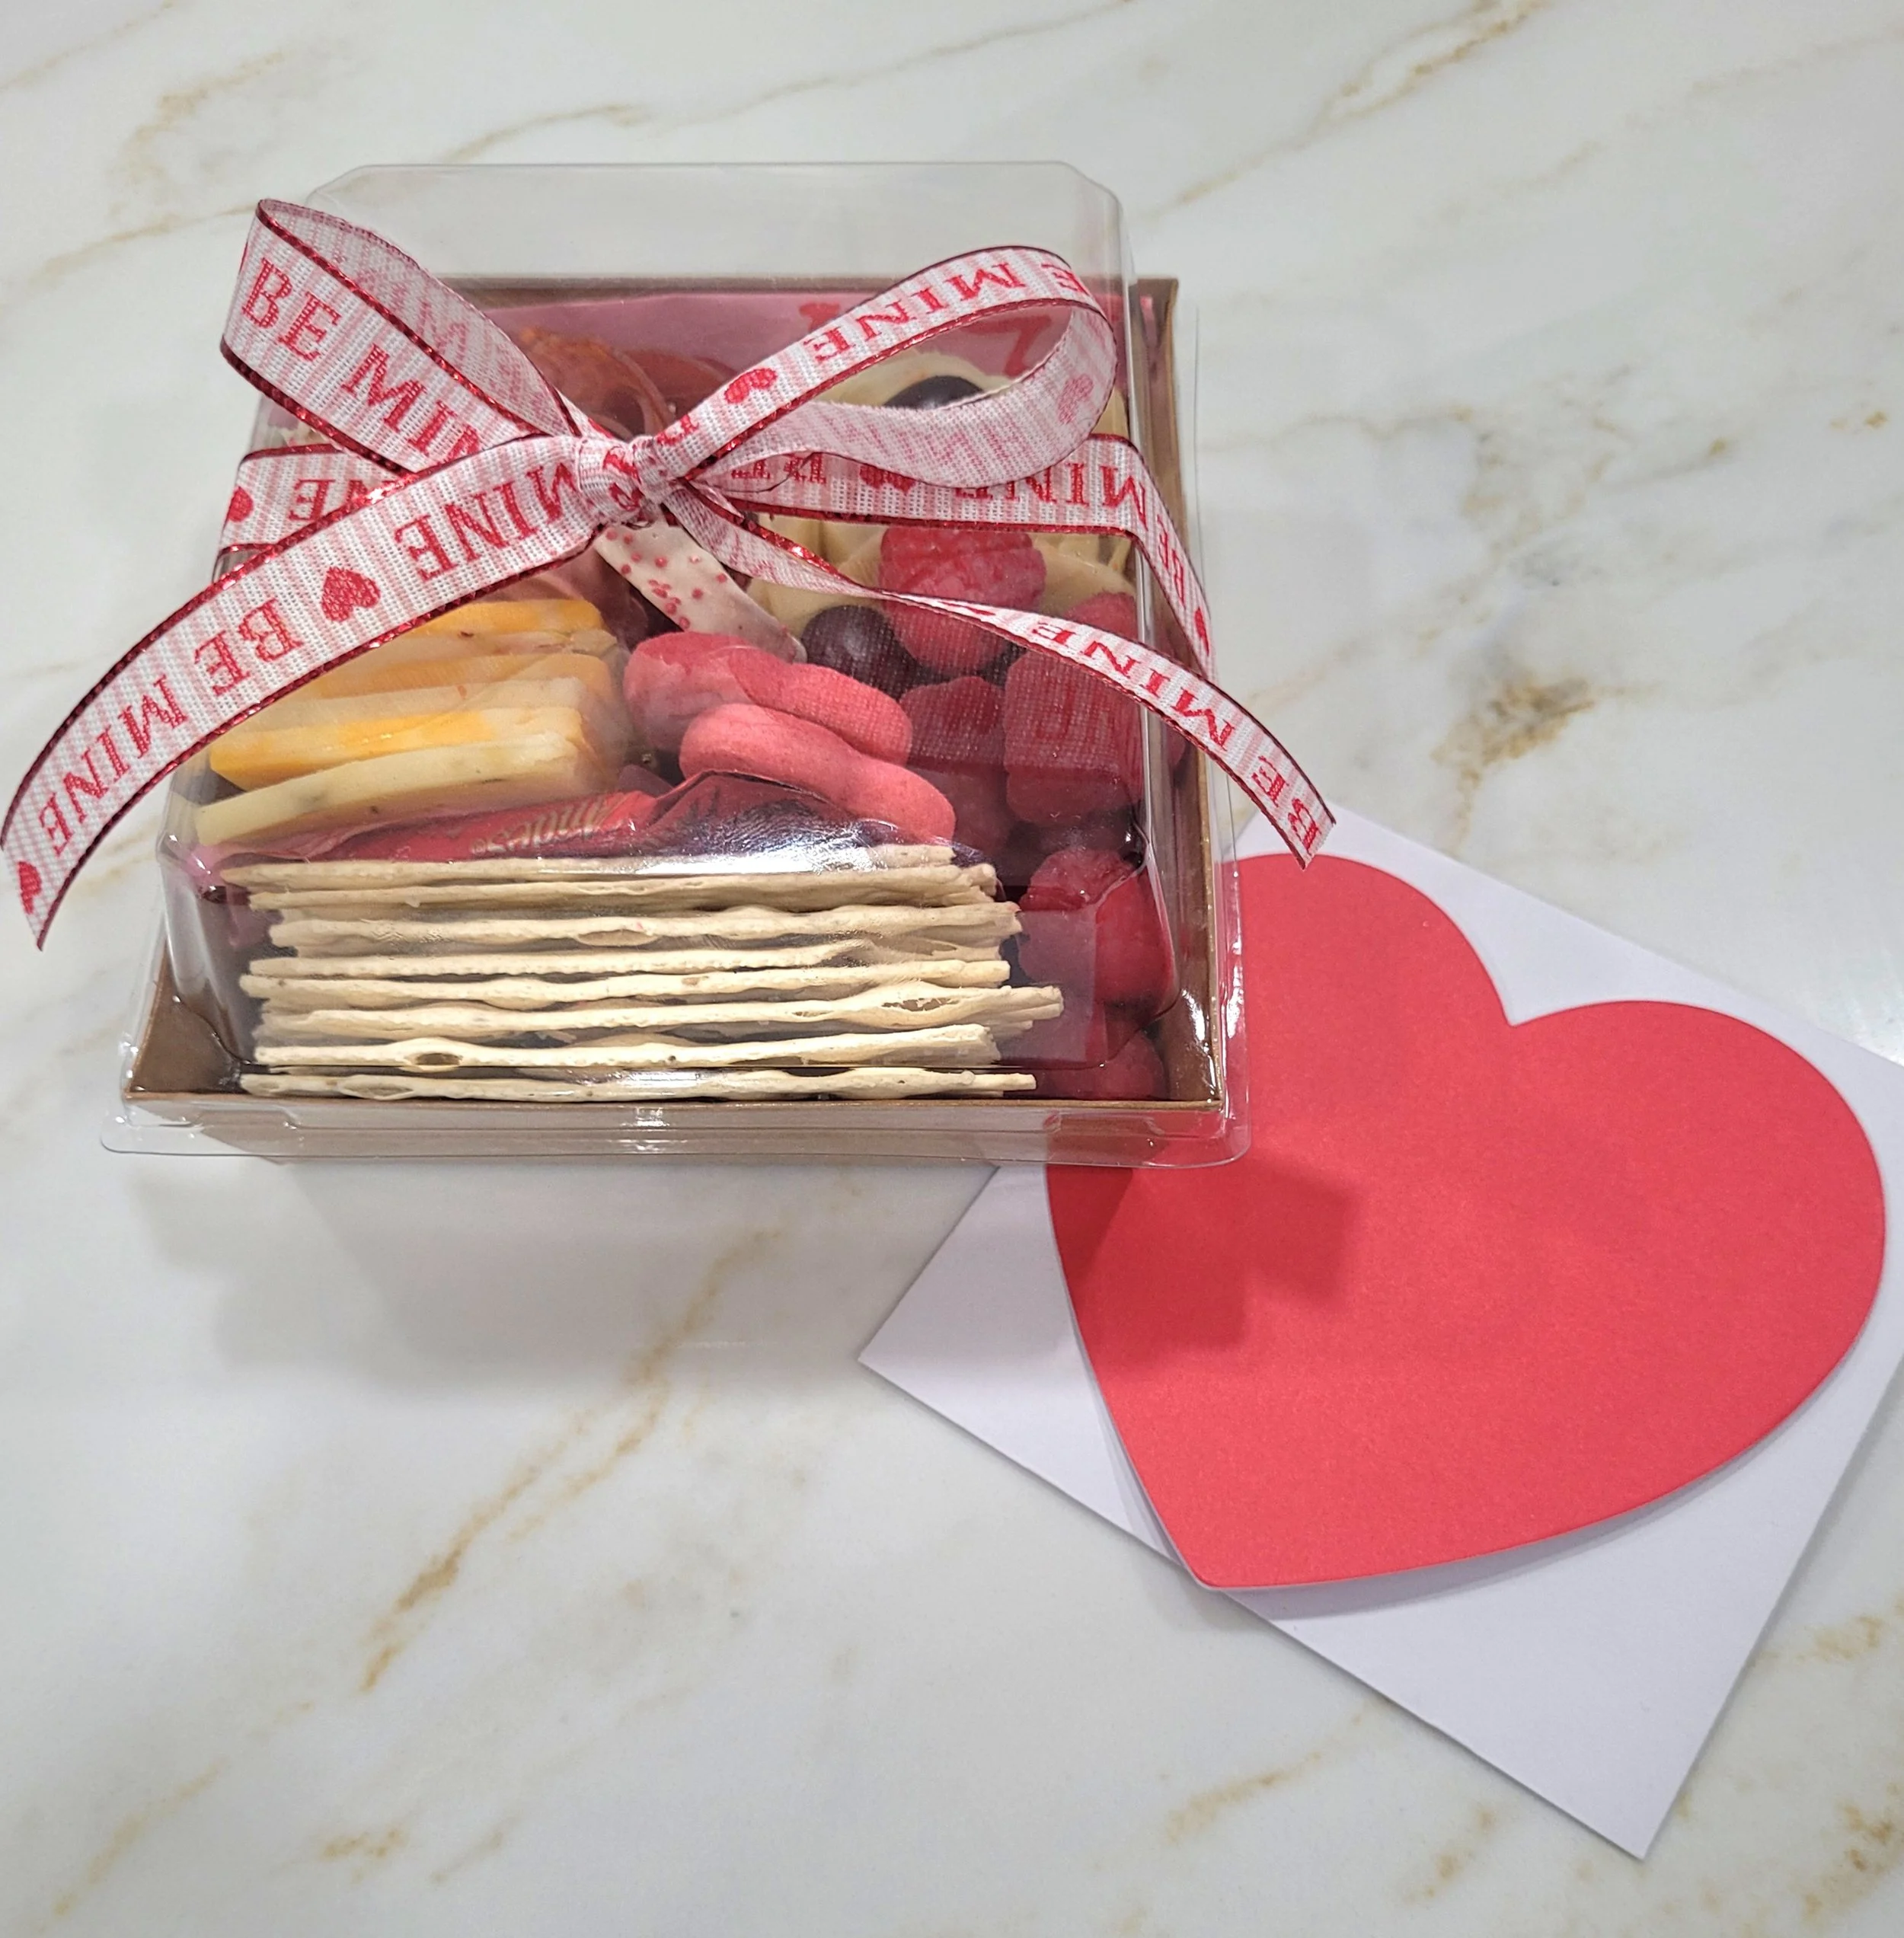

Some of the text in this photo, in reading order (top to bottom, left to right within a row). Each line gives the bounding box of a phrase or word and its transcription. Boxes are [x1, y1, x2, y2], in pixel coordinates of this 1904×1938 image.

[241, 257, 340, 362] BE
[803, 262, 1030, 364] MINE
[395, 461, 582, 583] MINE
[954, 461, 1148, 531] MIN
[39, 598, 304, 857] BE MINE
[1033, 621, 1321, 856] BE MINE
